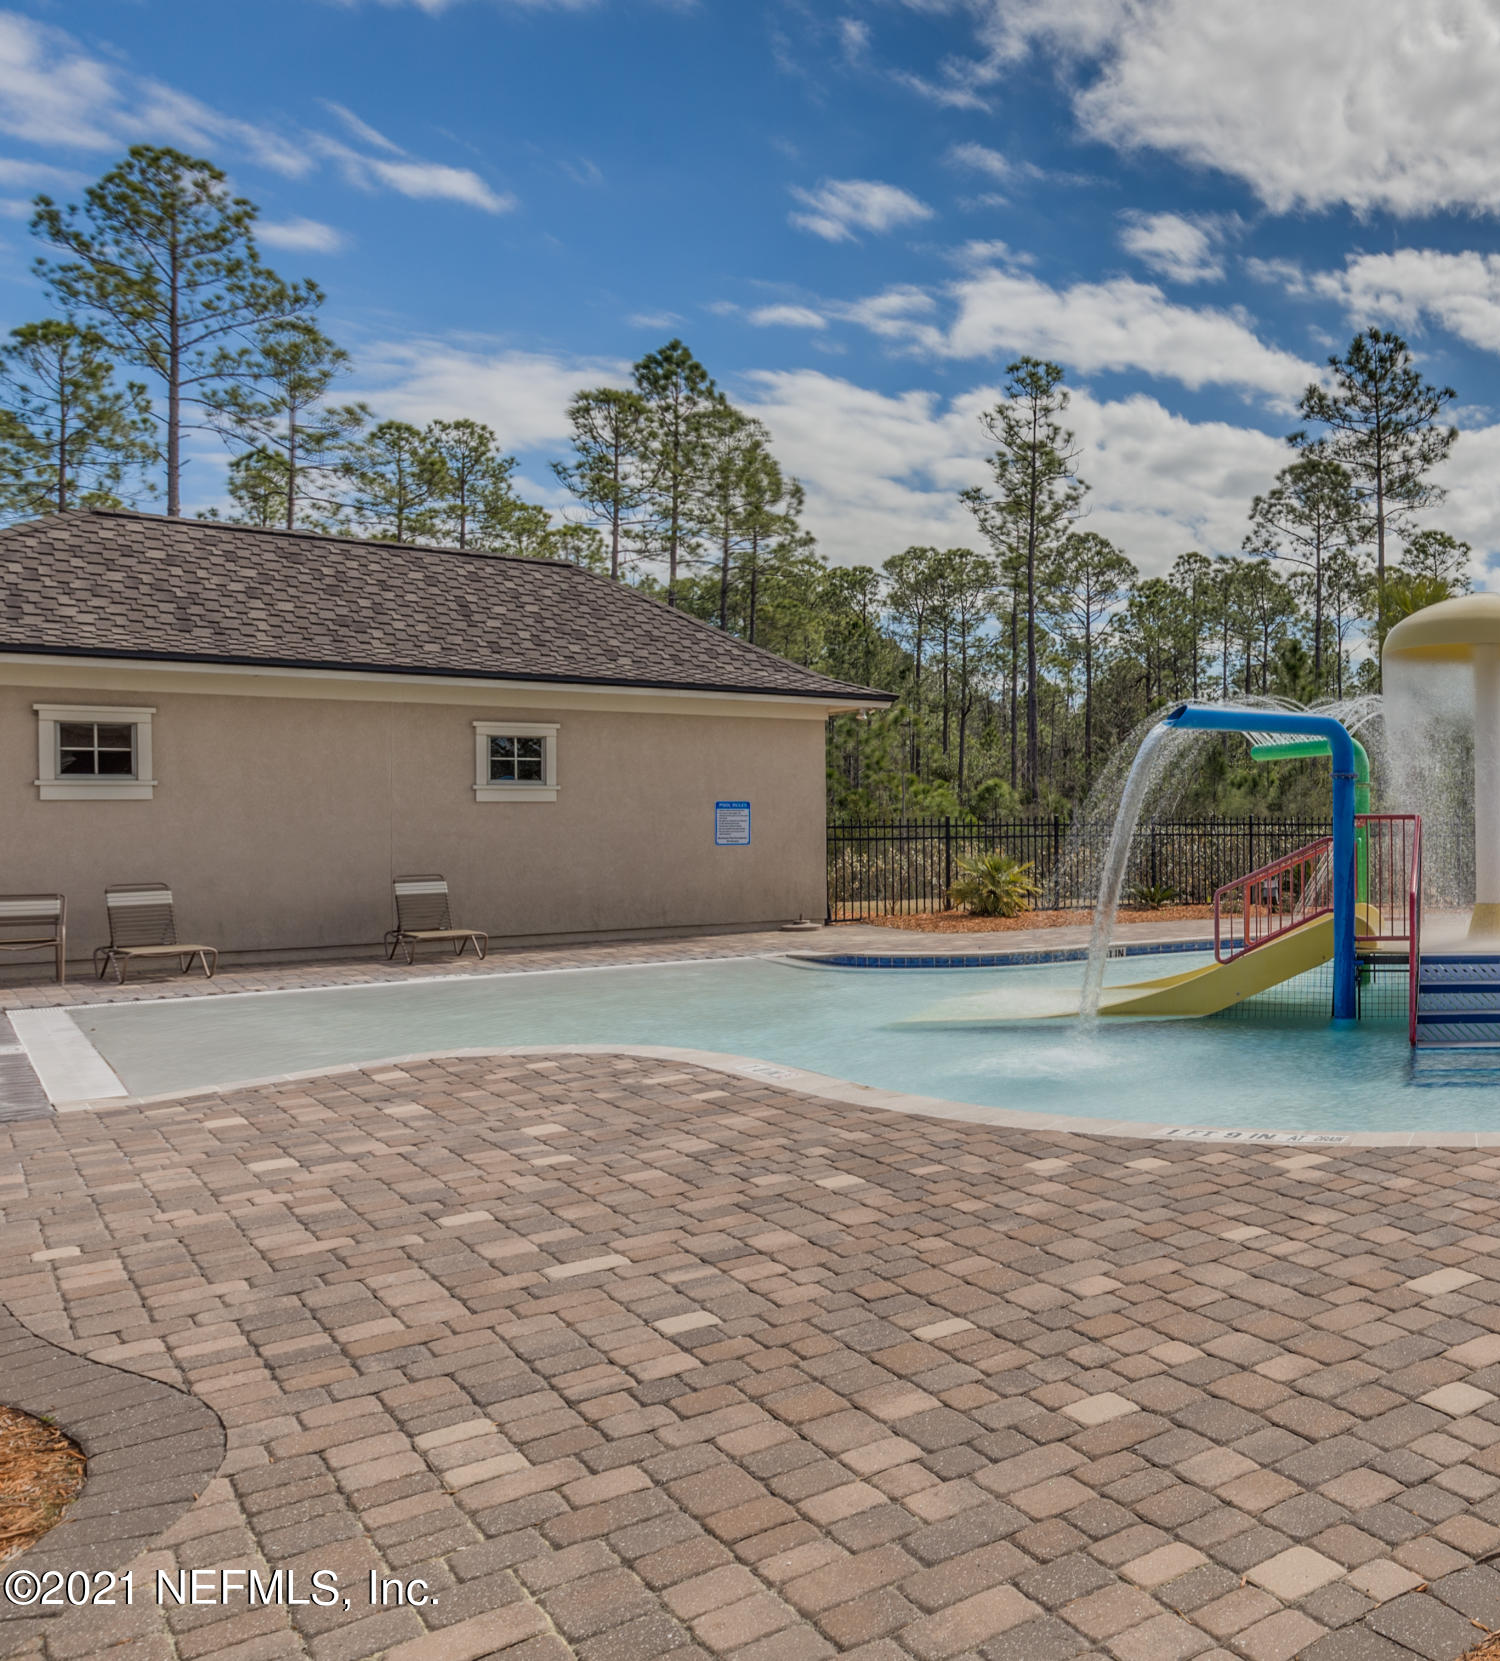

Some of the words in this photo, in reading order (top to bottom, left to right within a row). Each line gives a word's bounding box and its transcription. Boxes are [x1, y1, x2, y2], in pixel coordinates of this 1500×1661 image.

[1185, 1130, 1219, 1138] FT
[1223, 1131, 1243, 1139] 9
[1249, 1132, 1277, 1140] IN
[1287, 1134, 1305, 1142] AT
